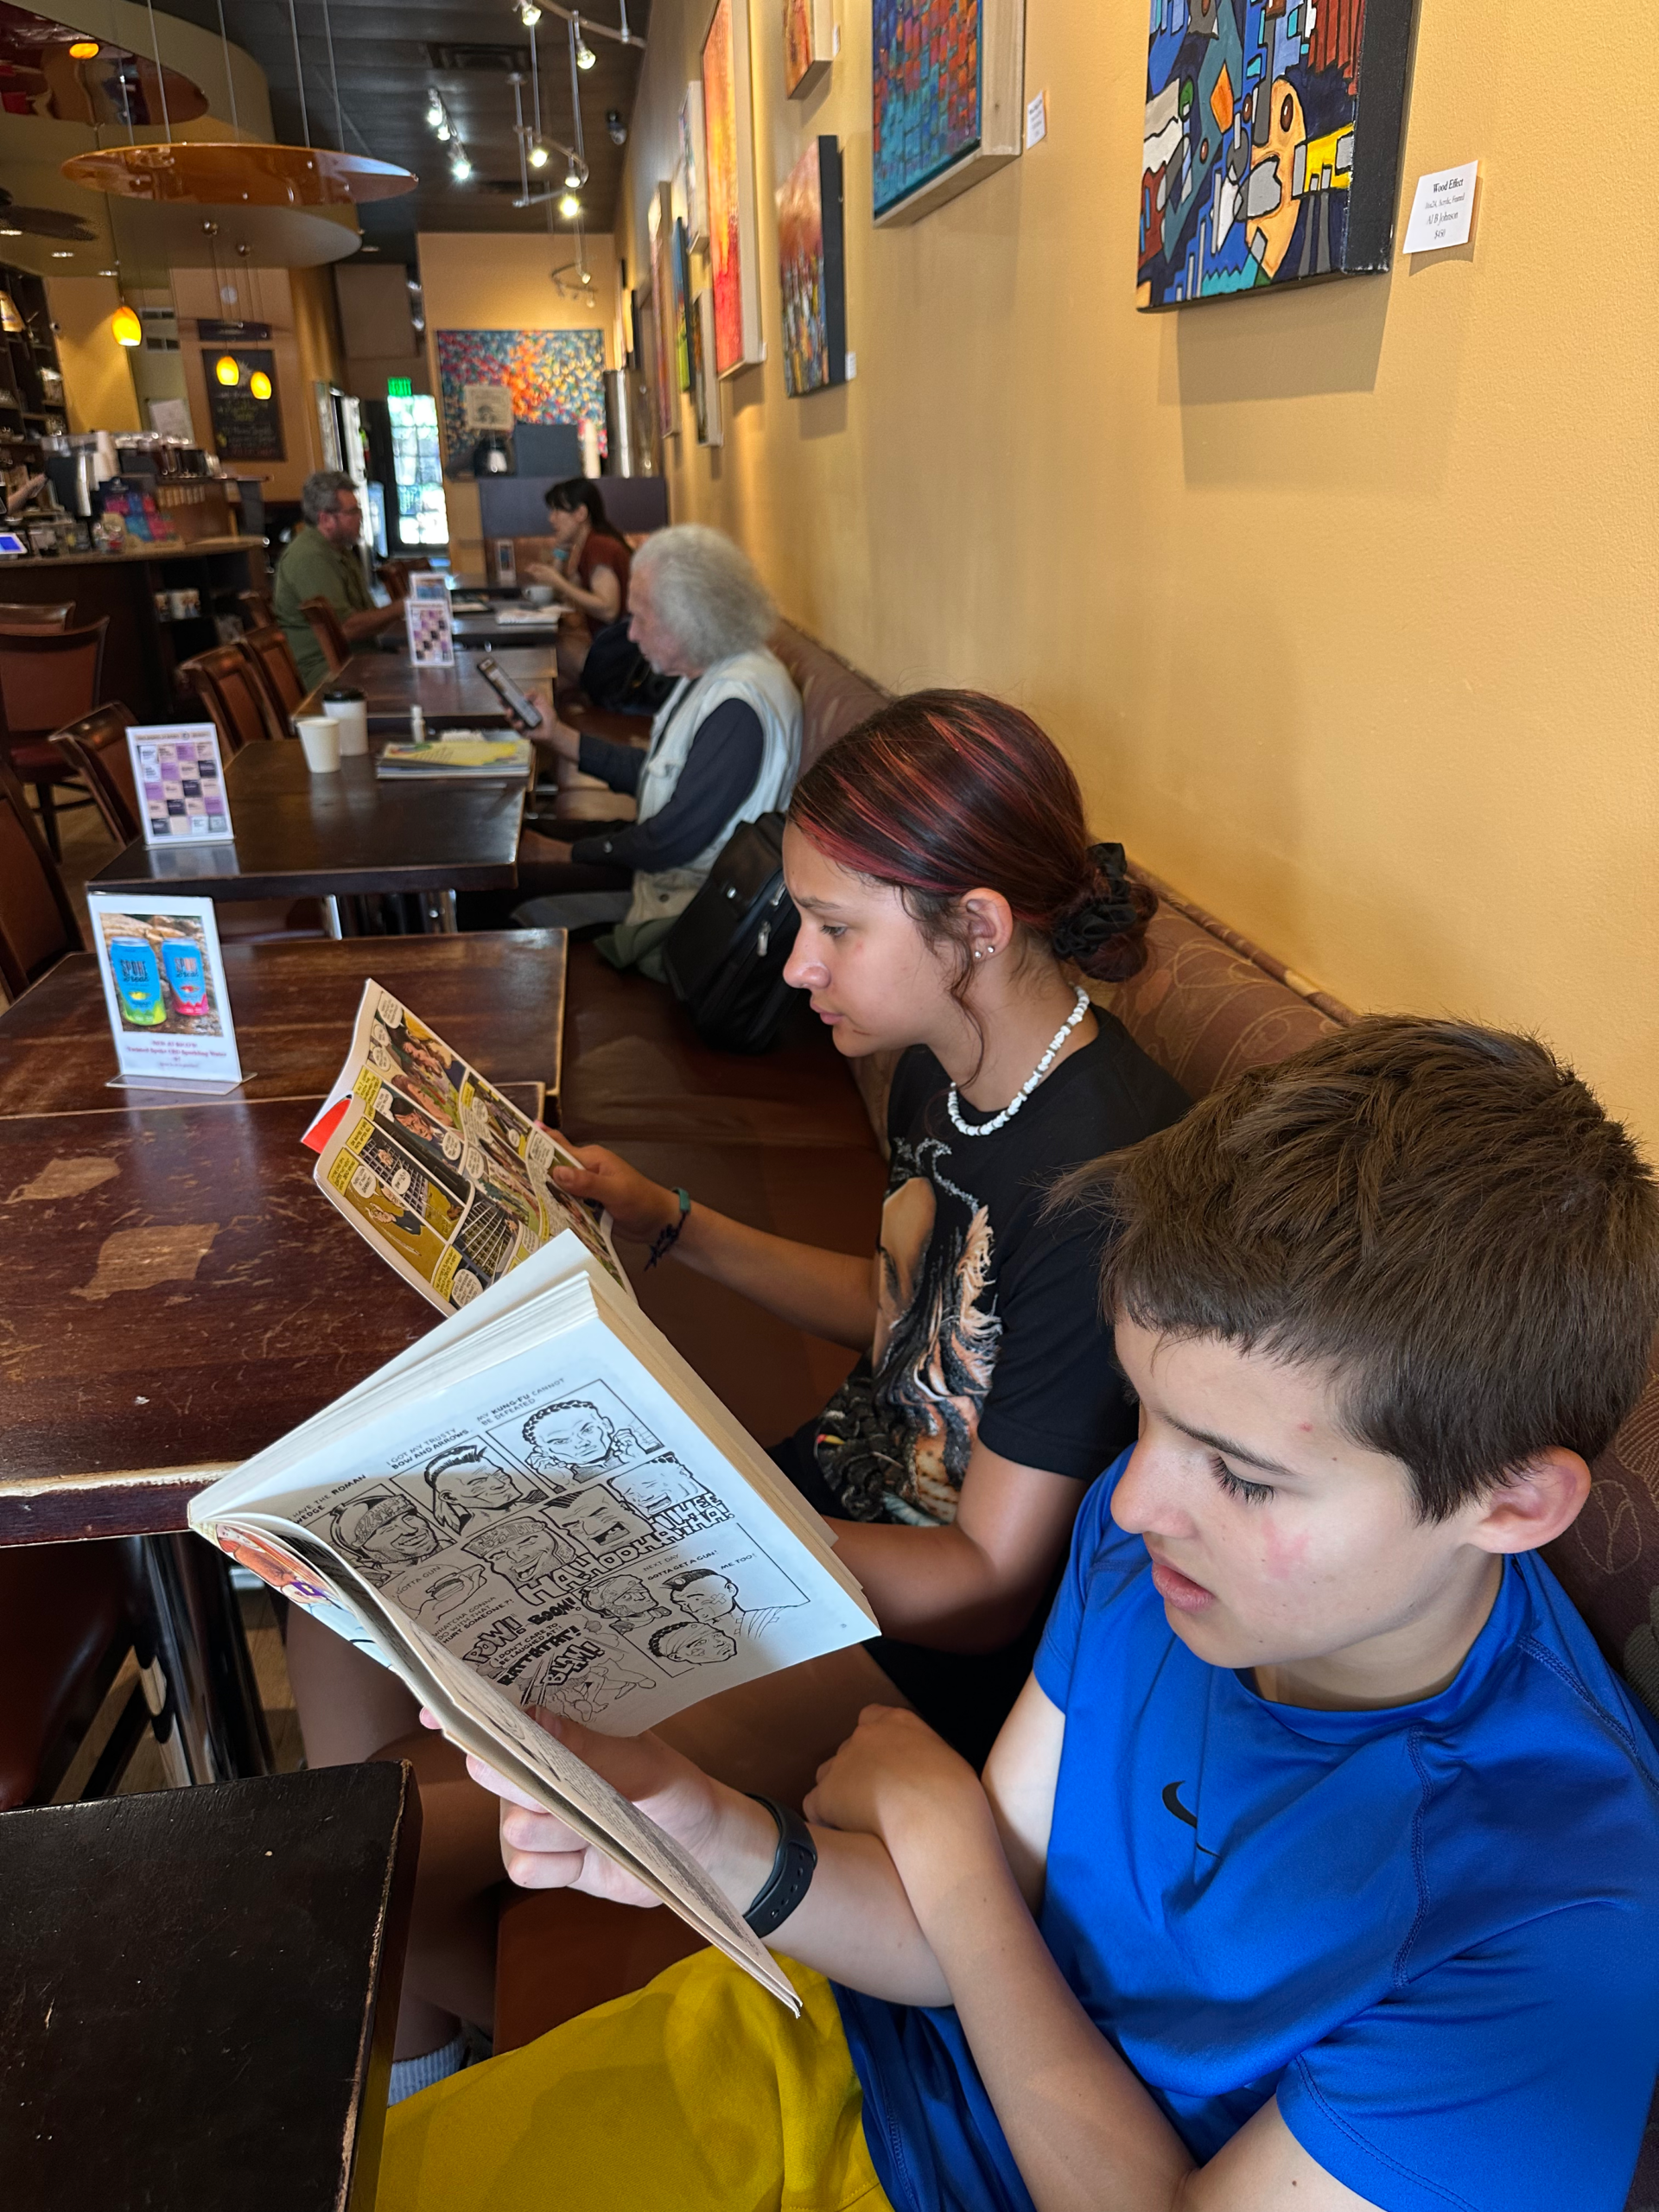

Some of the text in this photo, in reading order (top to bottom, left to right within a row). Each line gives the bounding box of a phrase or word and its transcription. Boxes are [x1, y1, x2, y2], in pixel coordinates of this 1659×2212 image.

[1433, 178, 1464, 193] Wood Effect
[1438, 212, 1459, 226] Johnson
[476, 1378, 565, 1421] MY KUNG-FU CANNOT
[495, 1398, 536, 1420] DEFEATED
[391, 1451, 408, 1463] GOT
[410, 1445, 424, 1453] MY
[425, 1427, 456, 1446] TRUSTY
[391, 1458, 414, 1470] BOW
[414, 1446, 433, 1459] AND
[293, 1503, 314, 1517] HAVE
[314, 1494, 331, 1505] THE
[331, 1474, 366, 1496] ROMAN
[295, 1505, 325, 1524] WEDGE
[643, 1554, 679, 1572] NEXT DAY
[647, 1568, 673, 1580] GOTTA
[673, 1561, 690, 1570] GET
[696, 1550, 718, 1560] GUN!
[735, 1553, 757, 1563] TOO!
[396, 1578, 422, 1594] GOTTA
[423, 1566, 441, 1578] GUN
[516, 1563, 591, 1606] HA!
[432, 1596, 497, 1637] WHATCHA GONNA
[437, 1605, 492, 1640] DO WITH THAT
[527, 1597, 582, 1625] BOOM!
[442, 1628, 463, 1643] HURT
[462, 1616, 526, 1664] POW!
[499, 1643, 523, 1659] DON'T
[525, 1630, 545, 1643] CARE
[511, 1636, 545, 1658] LAUGHED
[540, 1641, 605, 1685] BLAM!
